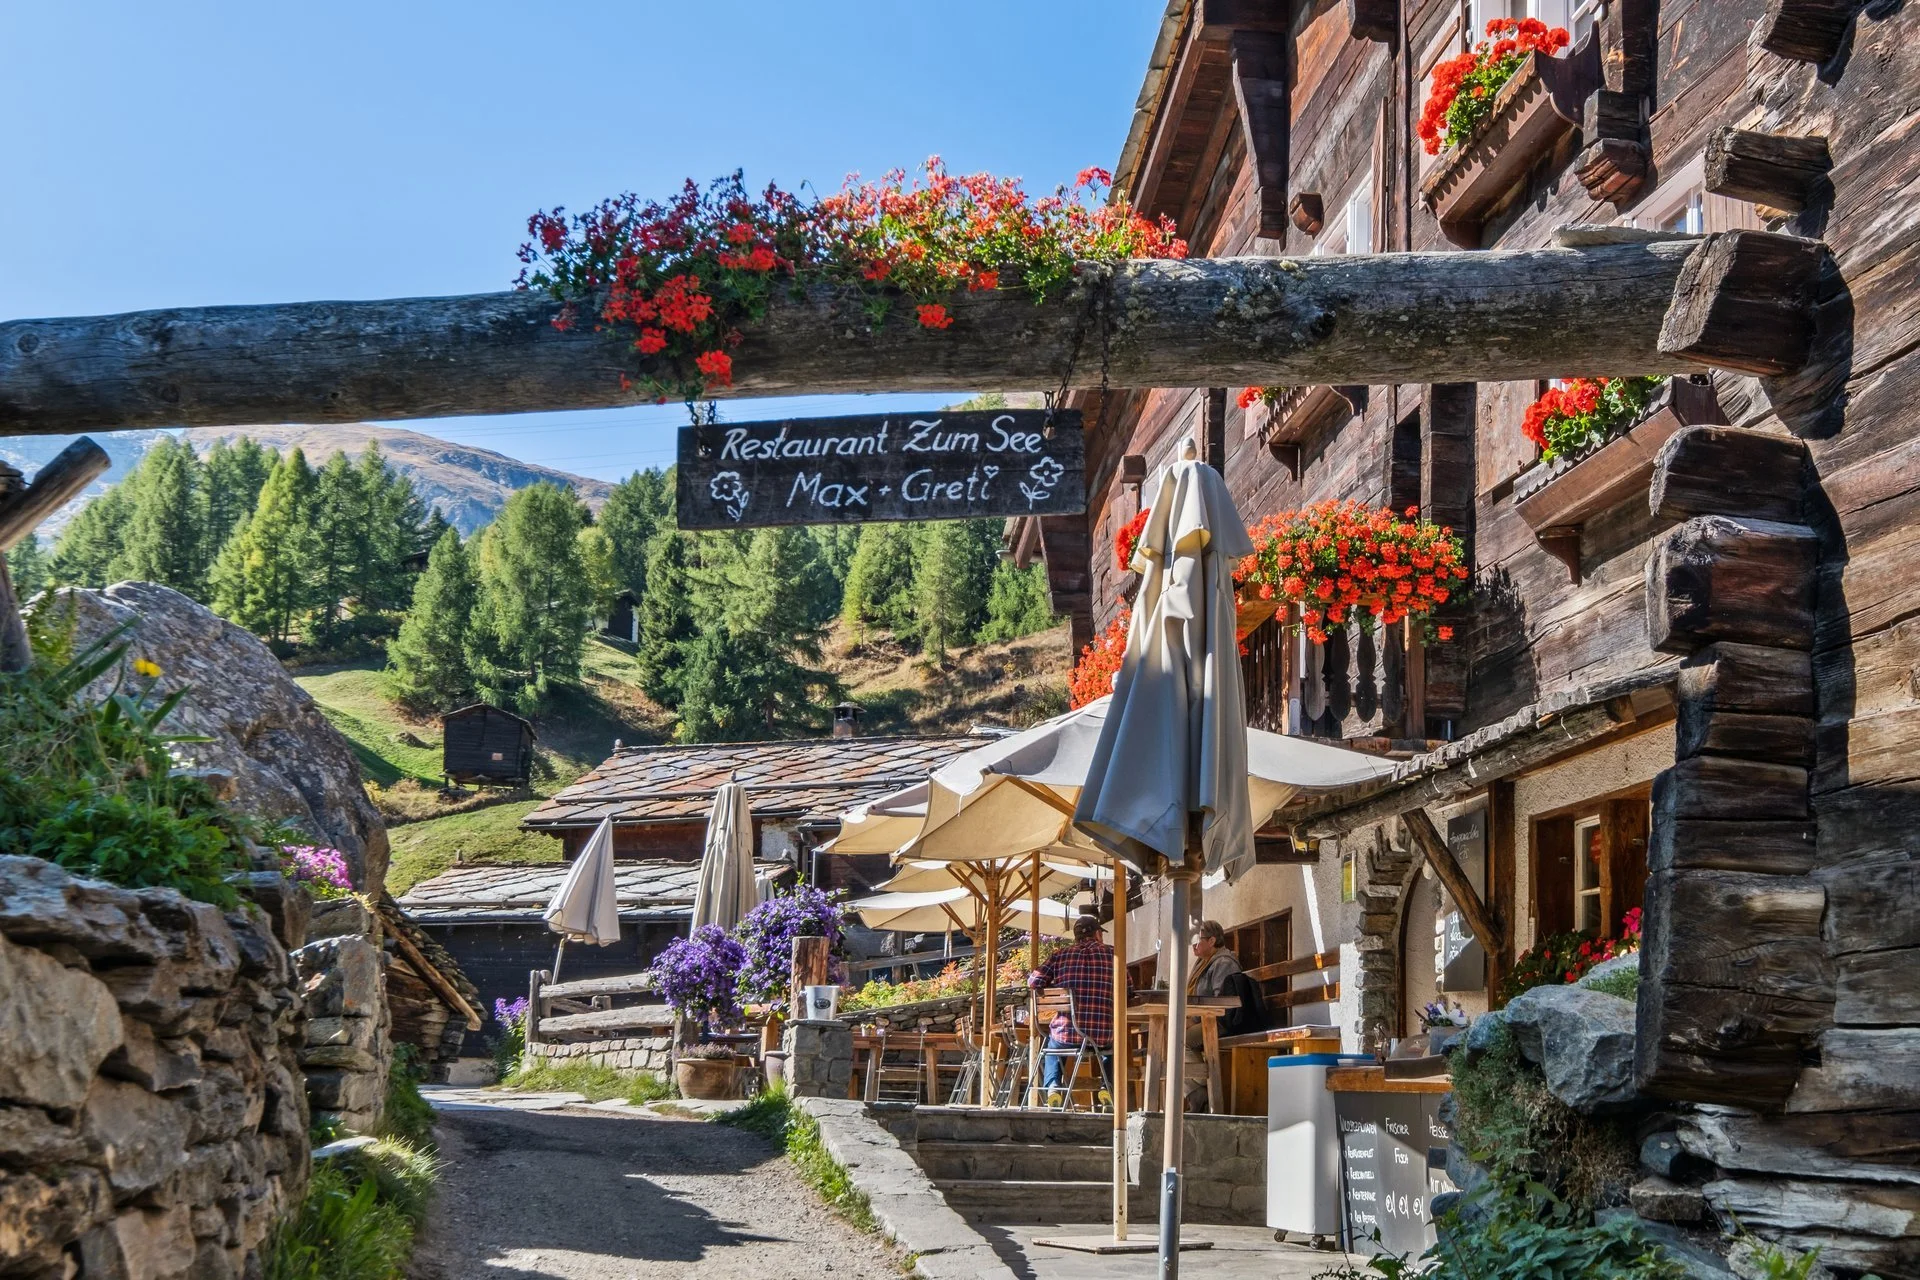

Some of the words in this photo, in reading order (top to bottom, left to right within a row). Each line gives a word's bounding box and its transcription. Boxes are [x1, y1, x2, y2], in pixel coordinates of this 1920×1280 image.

[720, 420, 889, 461] Restaurant
[902, 418, 978, 453] Zum
[986, 414, 1042, 454] See
[786, 471, 869, 508] Max
[901, 465, 999, 503] Greti
